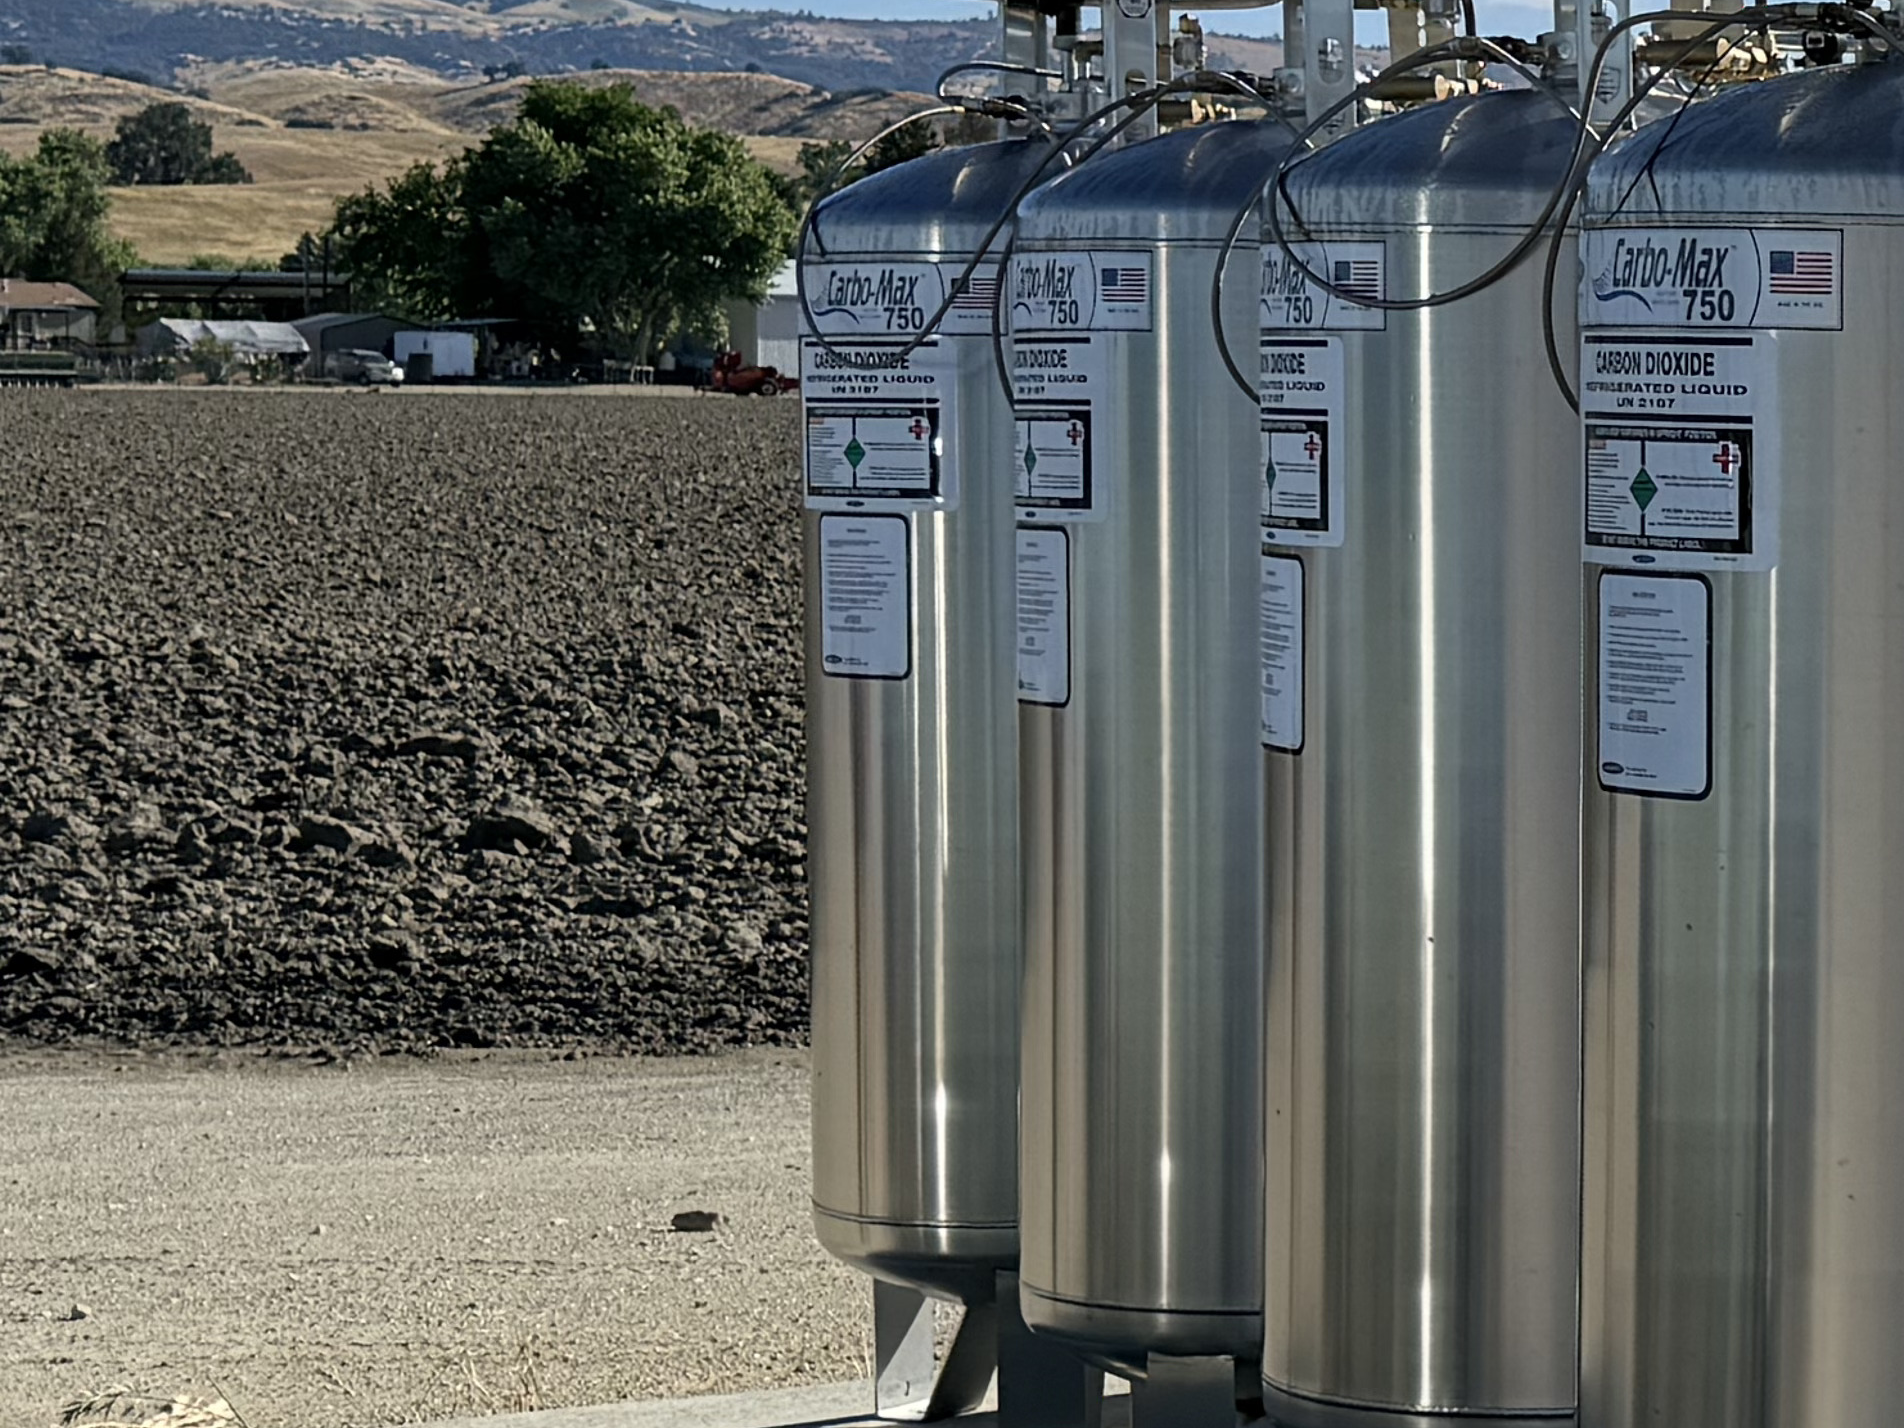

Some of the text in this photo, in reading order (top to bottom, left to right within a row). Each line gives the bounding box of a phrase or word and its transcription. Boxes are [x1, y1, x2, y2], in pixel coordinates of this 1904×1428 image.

[1612, 237, 1729, 289] Carbo-Max
[828, 268, 919, 307] Carbo-Max
[1048, 299, 1079, 325] 750
[1284, 296, 1313, 324] 750
[1682, 289, 1735, 322] 750
[883, 307, 924, 331] 750
[1596, 351, 1715, 377] CARBON DIOXIDE
[882, 375, 935, 384] LIQUID
[1681, 383, 1748, 396] LIQUID
